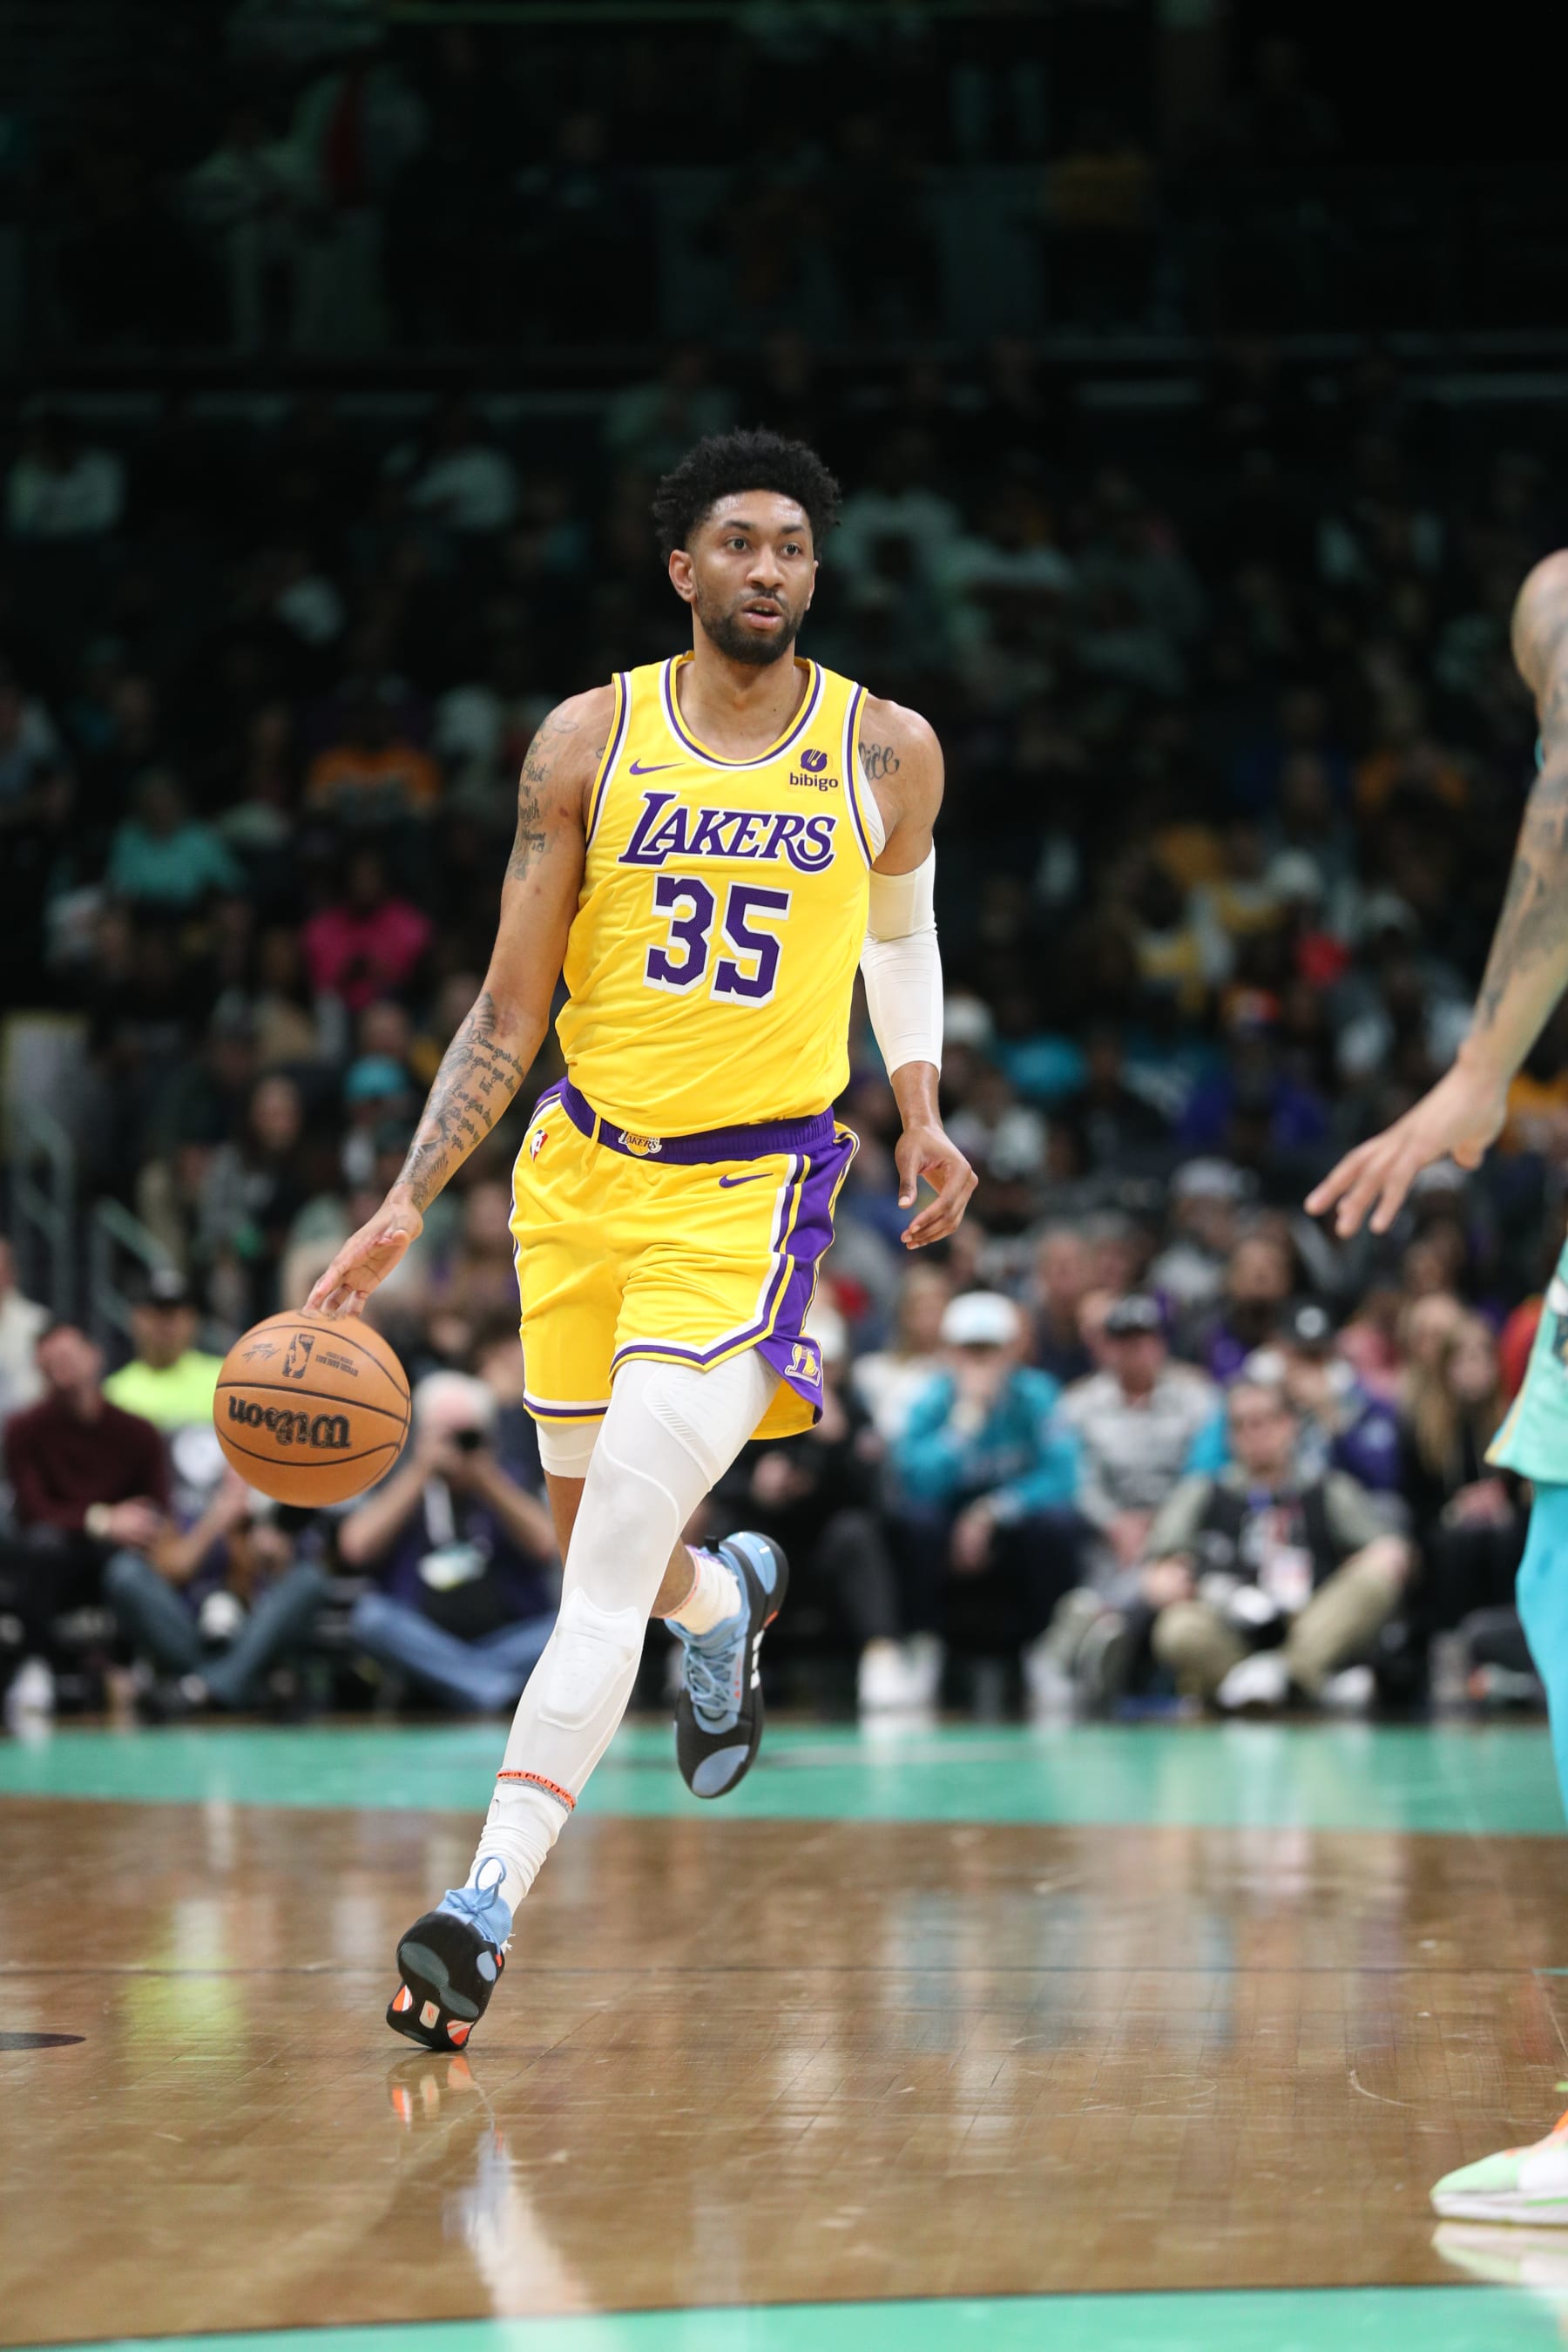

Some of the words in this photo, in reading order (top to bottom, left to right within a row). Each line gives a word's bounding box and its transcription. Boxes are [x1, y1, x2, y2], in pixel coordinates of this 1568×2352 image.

[789, 772, 839, 792] bibigo
[618, 791, 837, 875] LAKERS
[643, 873, 792, 1009] 35
[621, 1132, 659, 1152] LAKERS
[228, 1396, 352, 1450] Wilson
